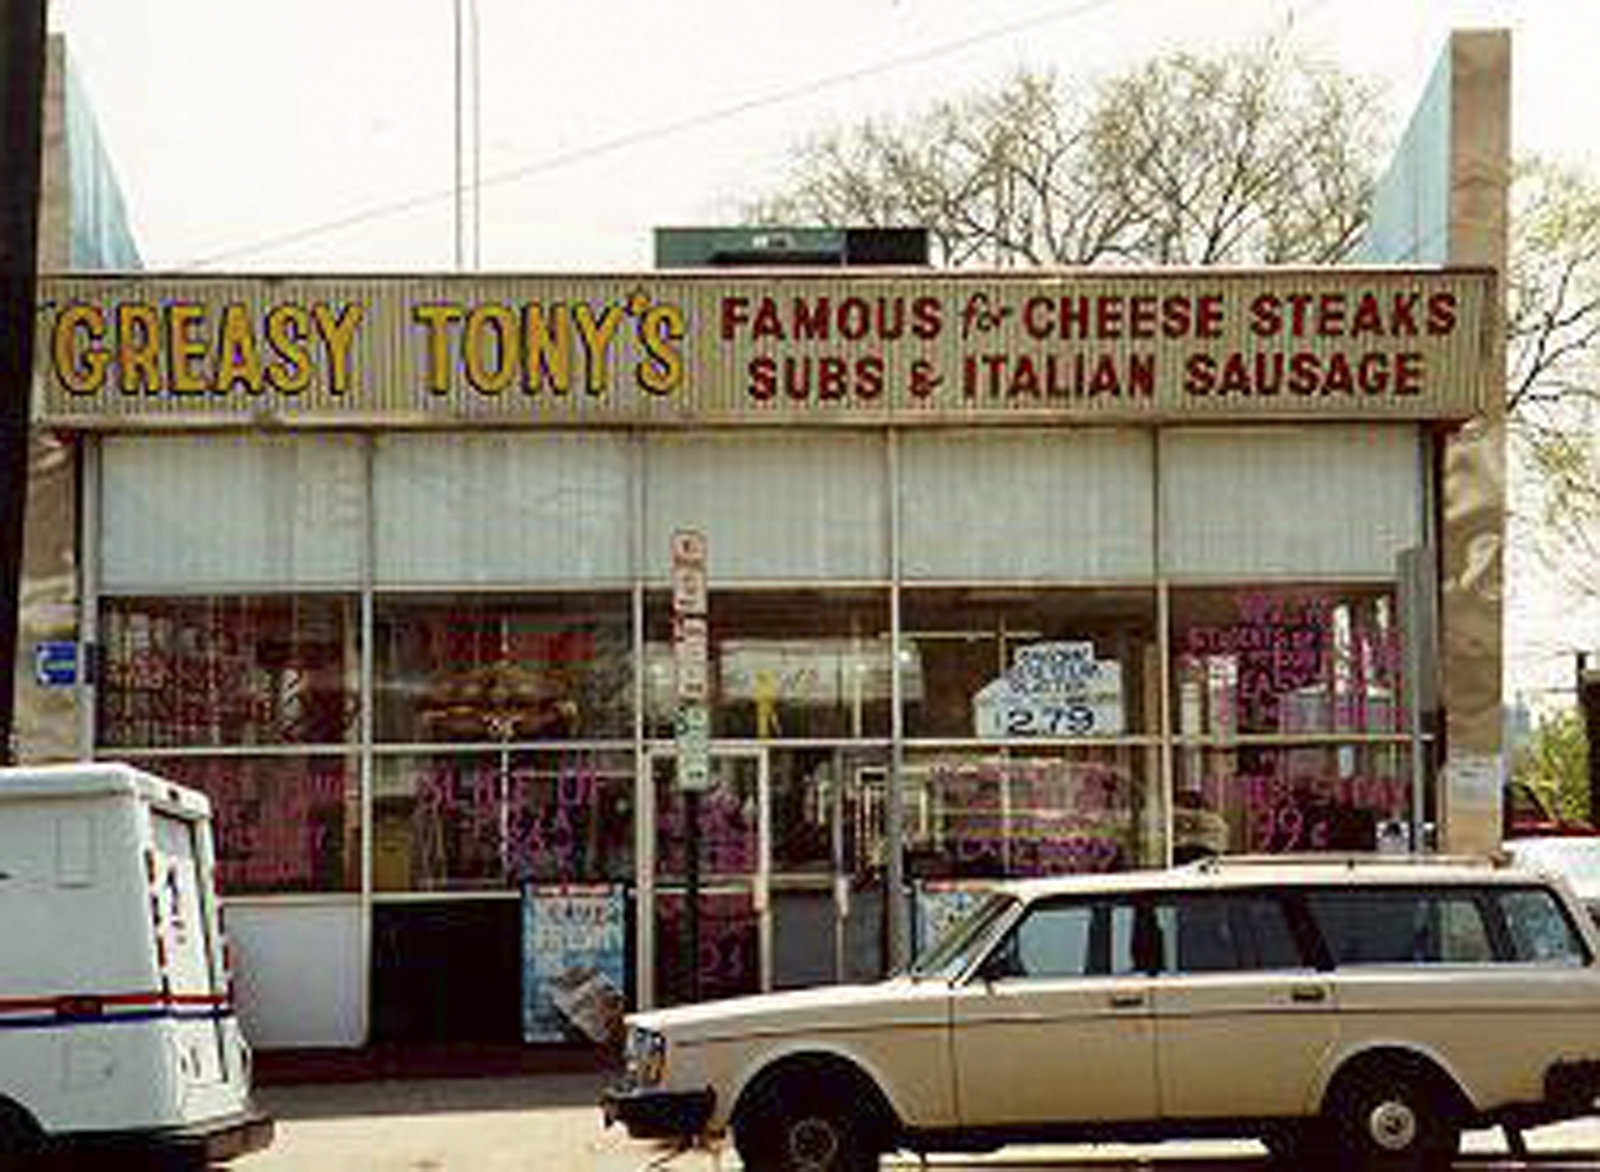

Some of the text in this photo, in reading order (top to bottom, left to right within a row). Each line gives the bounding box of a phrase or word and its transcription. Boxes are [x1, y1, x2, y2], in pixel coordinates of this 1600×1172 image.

[720, 296, 942, 341] FAMOUS
[1023, 296, 1224, 341] CHEESE
[1251, 293, 1457, 337] STEAKS
[747, 351, 1423, 402] SUBS & ITALIAN SAUSAGE
